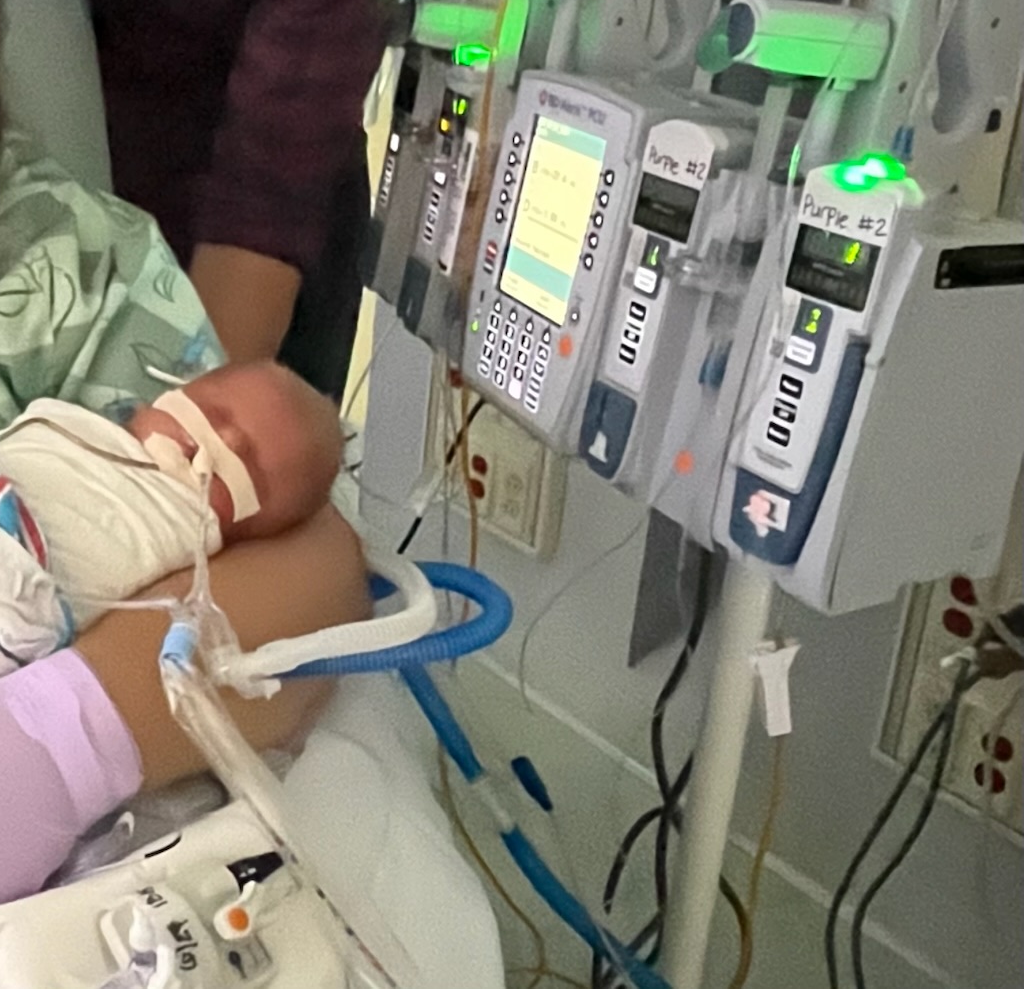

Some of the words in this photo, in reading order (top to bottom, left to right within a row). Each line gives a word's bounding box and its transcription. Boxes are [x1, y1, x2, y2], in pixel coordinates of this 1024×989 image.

[685, 160, 707, 181] #2
[802, 193, 850, 229] Purple
[858, 215, 888, 238] #2
